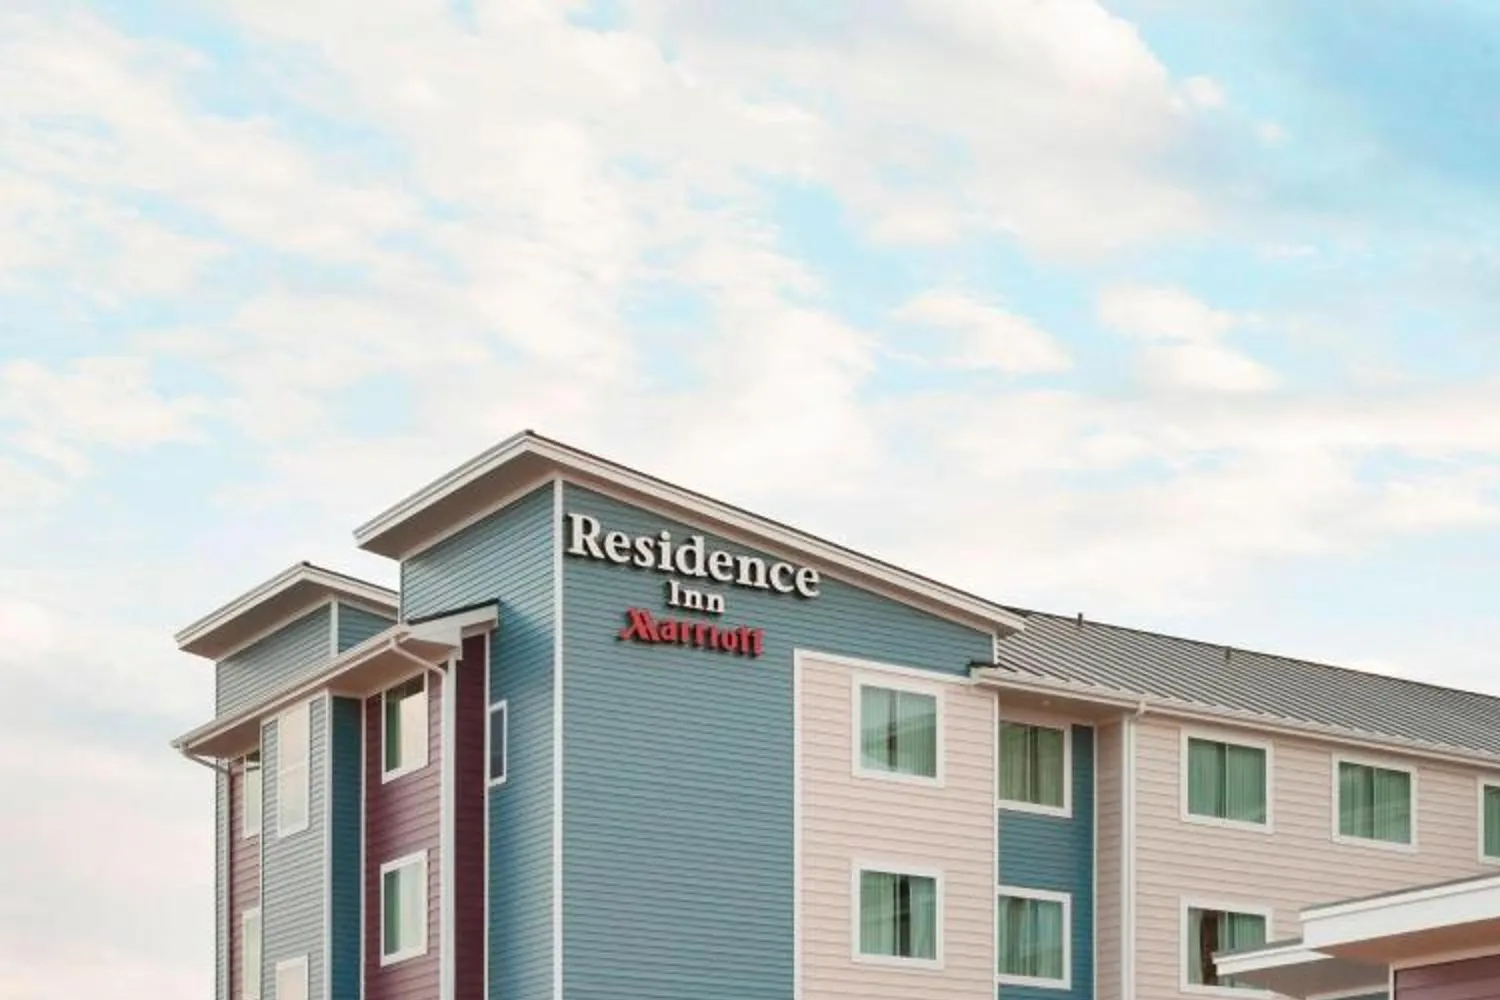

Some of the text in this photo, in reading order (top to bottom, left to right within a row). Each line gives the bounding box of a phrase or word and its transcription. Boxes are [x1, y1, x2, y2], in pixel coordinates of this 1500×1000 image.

[567, 512, 820, 598] Residence
[667, 578, 726, 614] Inn
[619, 607, 766, 656] Marriott
